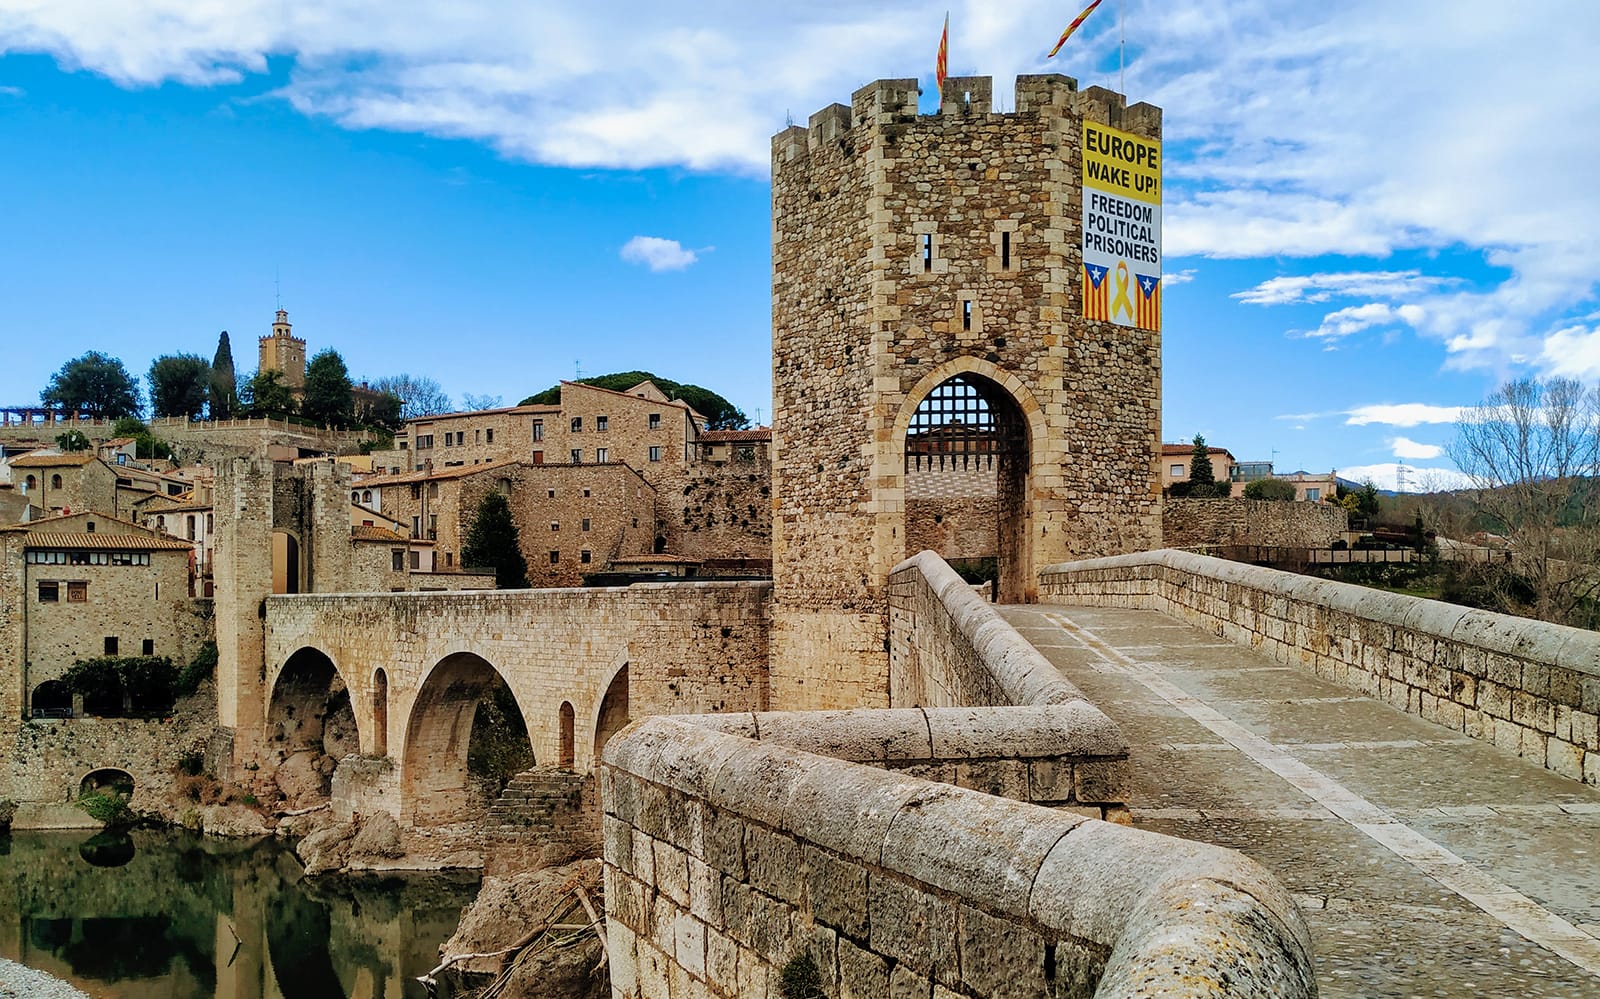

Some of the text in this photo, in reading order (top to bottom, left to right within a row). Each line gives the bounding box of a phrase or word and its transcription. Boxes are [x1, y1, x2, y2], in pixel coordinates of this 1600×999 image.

[1086, 128, 1157, 169] EUROPE
[1087, 159, 1157, 195] WAKE UP!
[1092, 193, 1152, 224] FREEDOM
[1088, 213, 1155, 244] POLITICAL
[1085, 232, 1158, 264] PRISONERS
